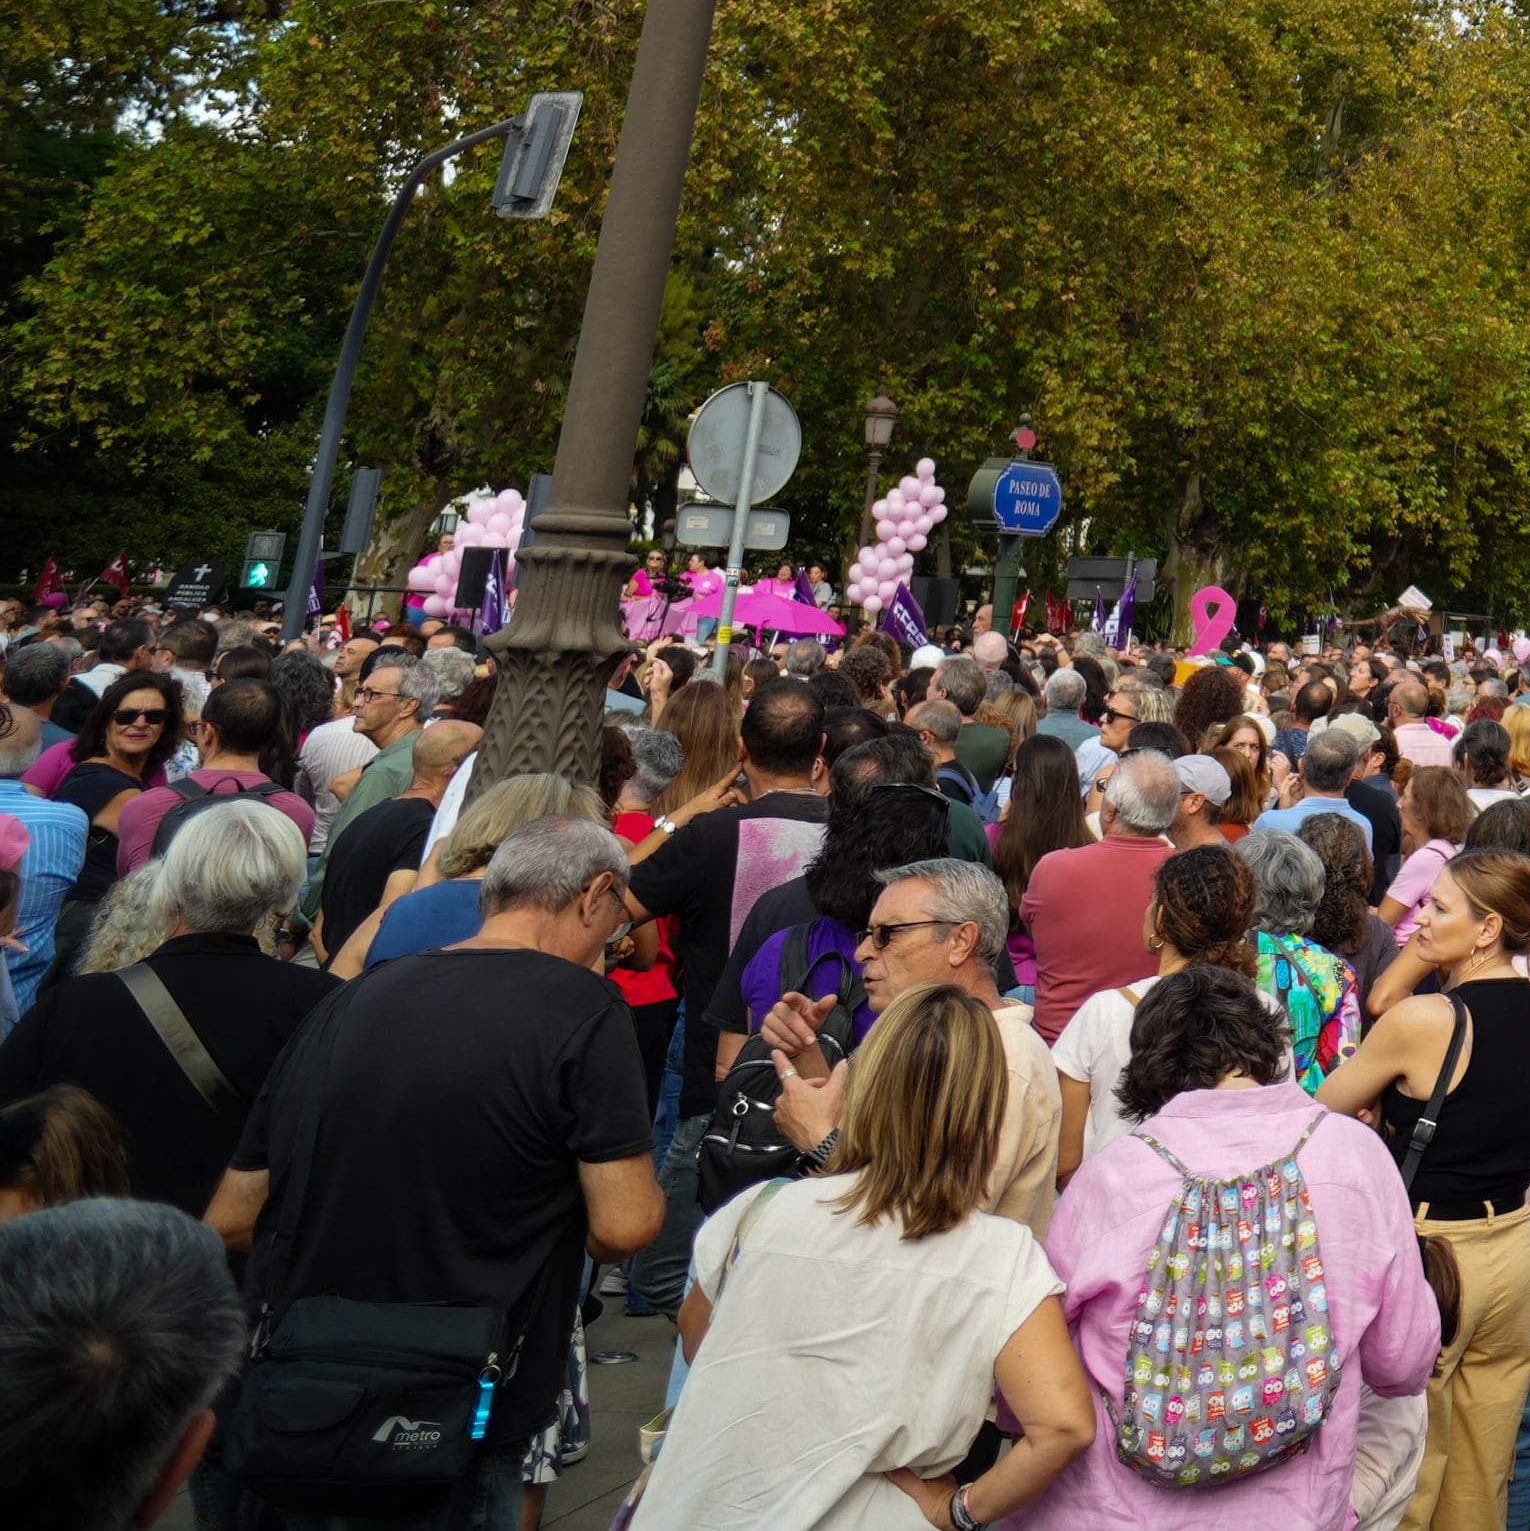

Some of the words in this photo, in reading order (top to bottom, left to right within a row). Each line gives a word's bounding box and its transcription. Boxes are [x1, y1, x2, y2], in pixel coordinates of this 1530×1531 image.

[1009, 479, 1037, 496] PASEO
[1039, 483, 1051, 498] DE
[1014, 499, 1040, 517] ROMA
[394, 1431, 441, 1442] metro
